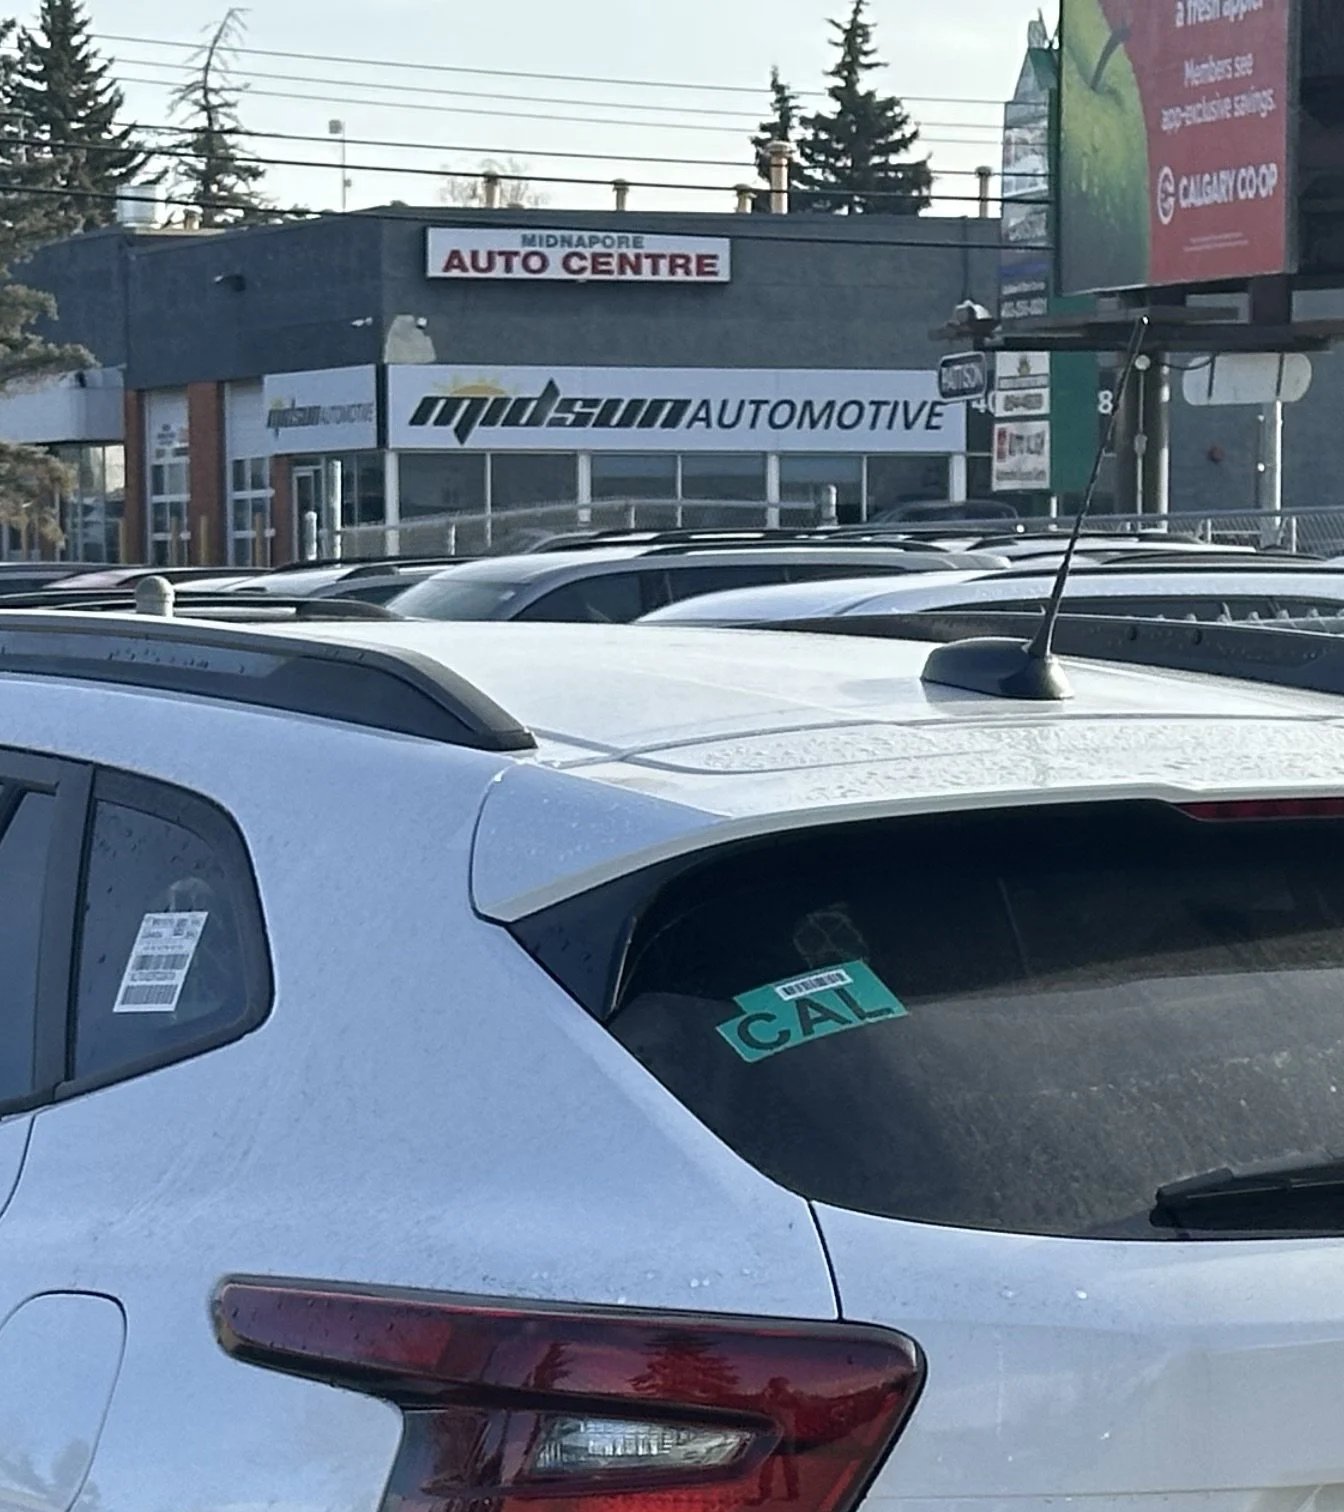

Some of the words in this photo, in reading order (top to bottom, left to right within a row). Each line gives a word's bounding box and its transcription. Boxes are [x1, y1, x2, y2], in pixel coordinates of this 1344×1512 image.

[1183, 55, 1233, 87] Members
[1234, 53, 1253, 77] see
[1161, 91, 1233, 134] app-exclusive
[1178, 169, 1236, 208] CALGARY
[521, 233, 645, 250] MIDNAPORE
[441, 250, 550, 274] AUTO
[561, 250, 720, 277] CENTRE
[408, 377, 693, 446] midsun
[686, 398, 945, 431] AUTOMOTIVE
[737, 987, 895, 1051] CAL
